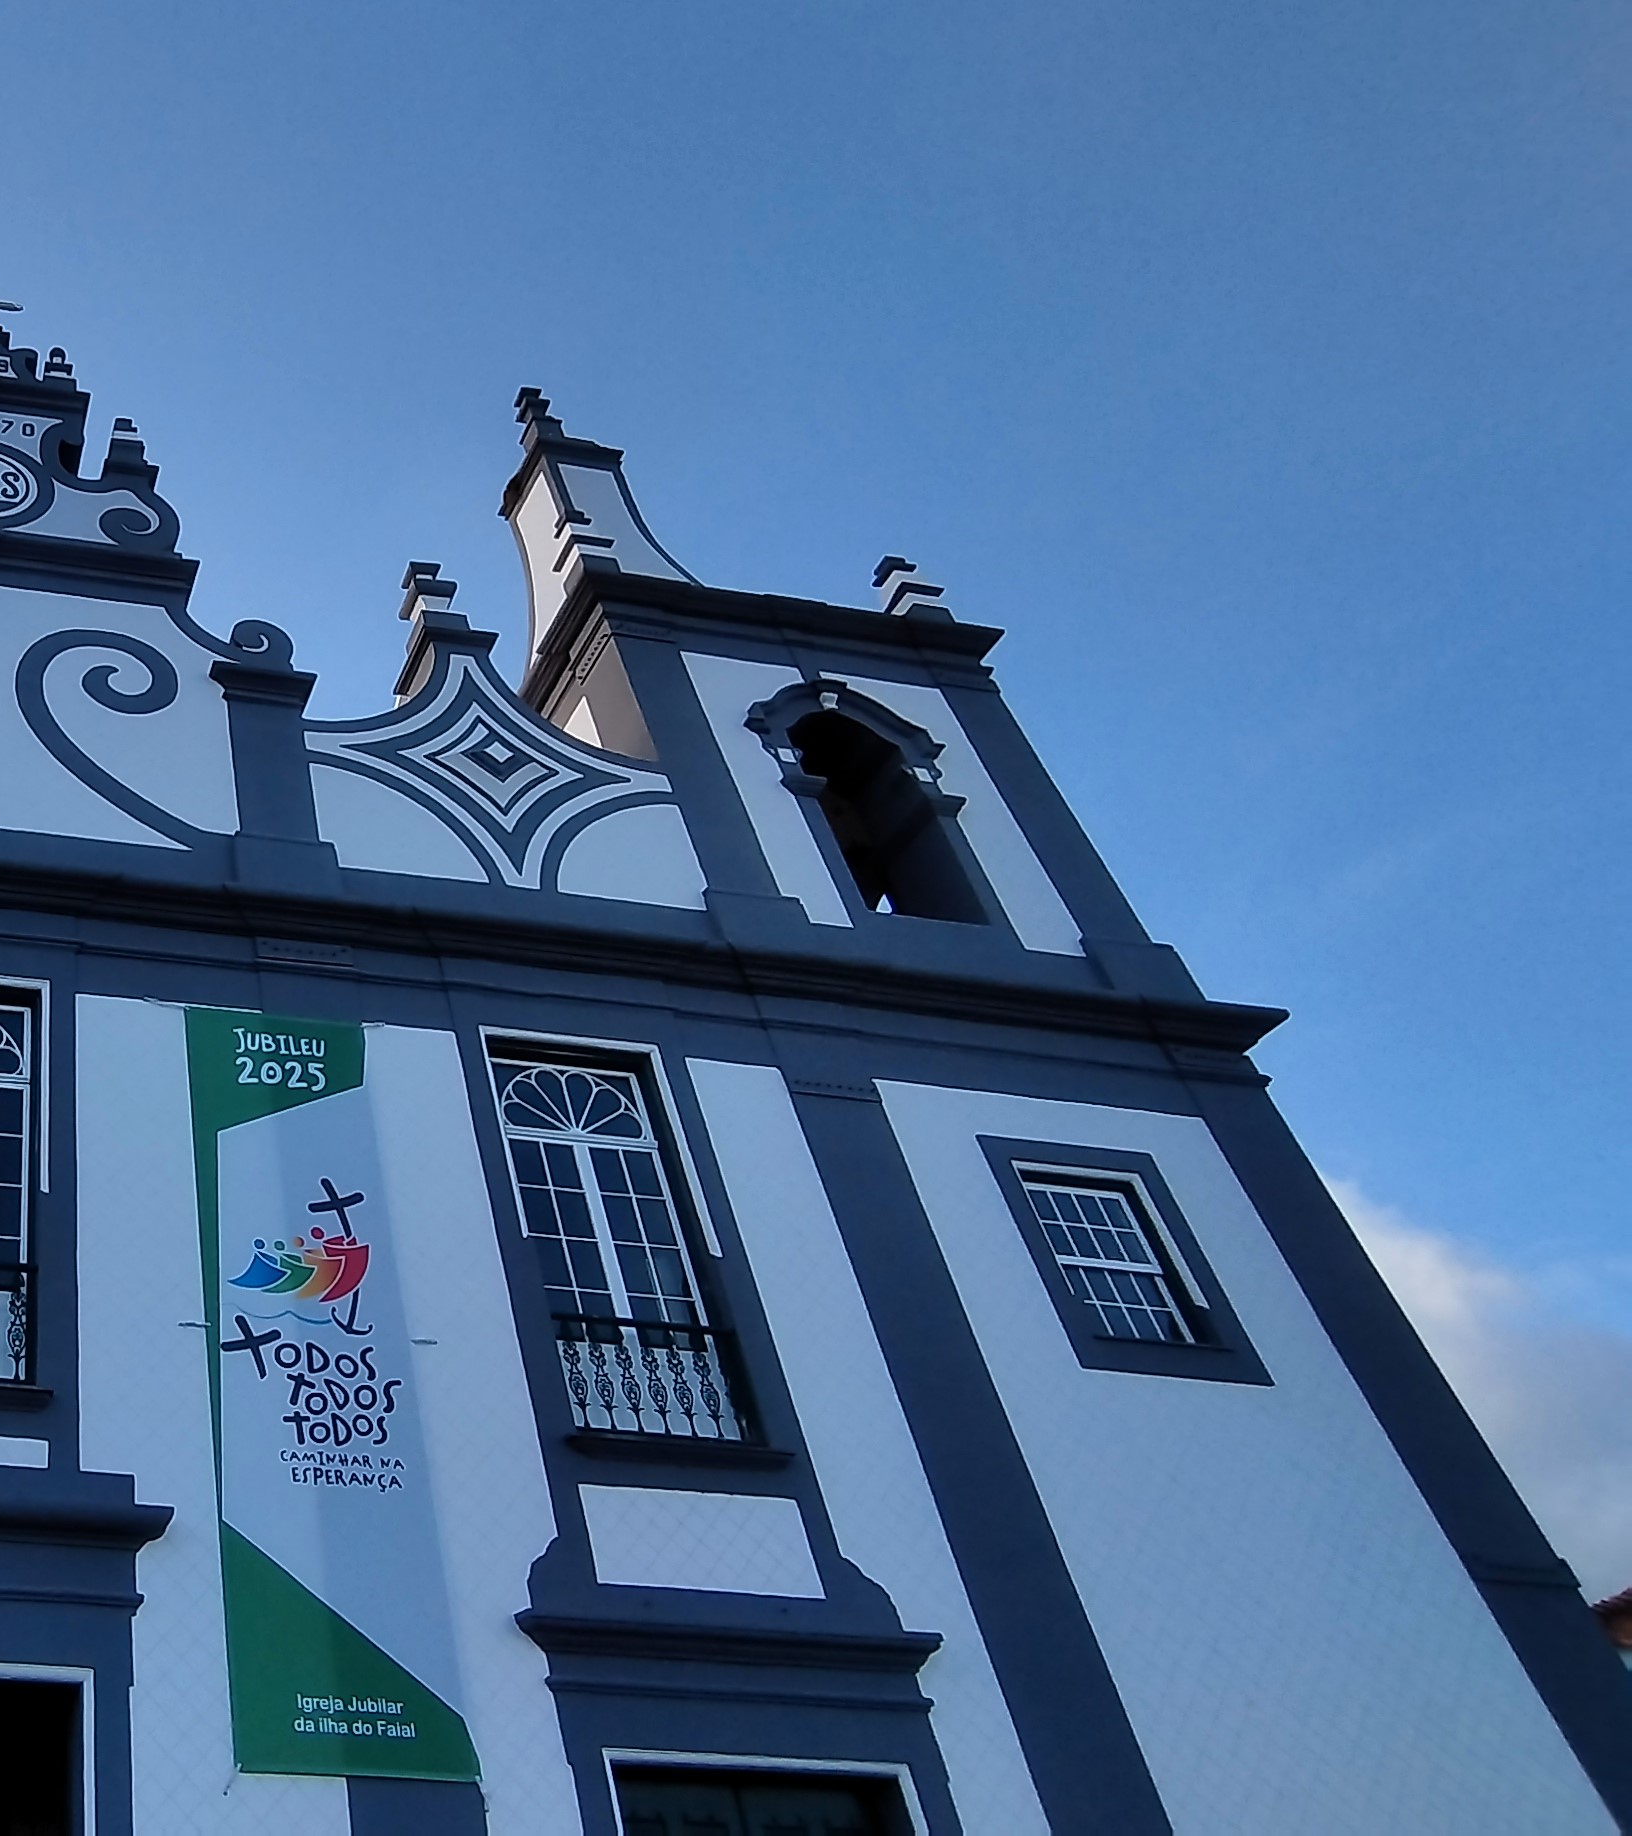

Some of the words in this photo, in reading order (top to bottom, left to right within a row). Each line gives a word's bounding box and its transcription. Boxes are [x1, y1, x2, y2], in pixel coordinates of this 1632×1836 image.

[232, 1027, 326, 1058] JUBILEU
[234, 1056, 326, 1092] 2025
[221, 1315, 377, 1381] TODOS
[286, 1372, 402, 1415] TODOS
[282, 1411, 388, 1447] TODOS
[280, 1450, 373, 1469] CAMINHAR
[379, 1457, 405, 1471] NA
[291, 1467, 403, 1493] ESPERANÇA
[296, 1693, 344, 1714] Igreja
[347, 1696, 404, 1716] Jubilar
[293, 1717, 315, 1733] da
[319, 1718, 348, 1735] ilha
[352, 1719, 373, 1736] do
[377, 1720, 416, 1738] Faial
